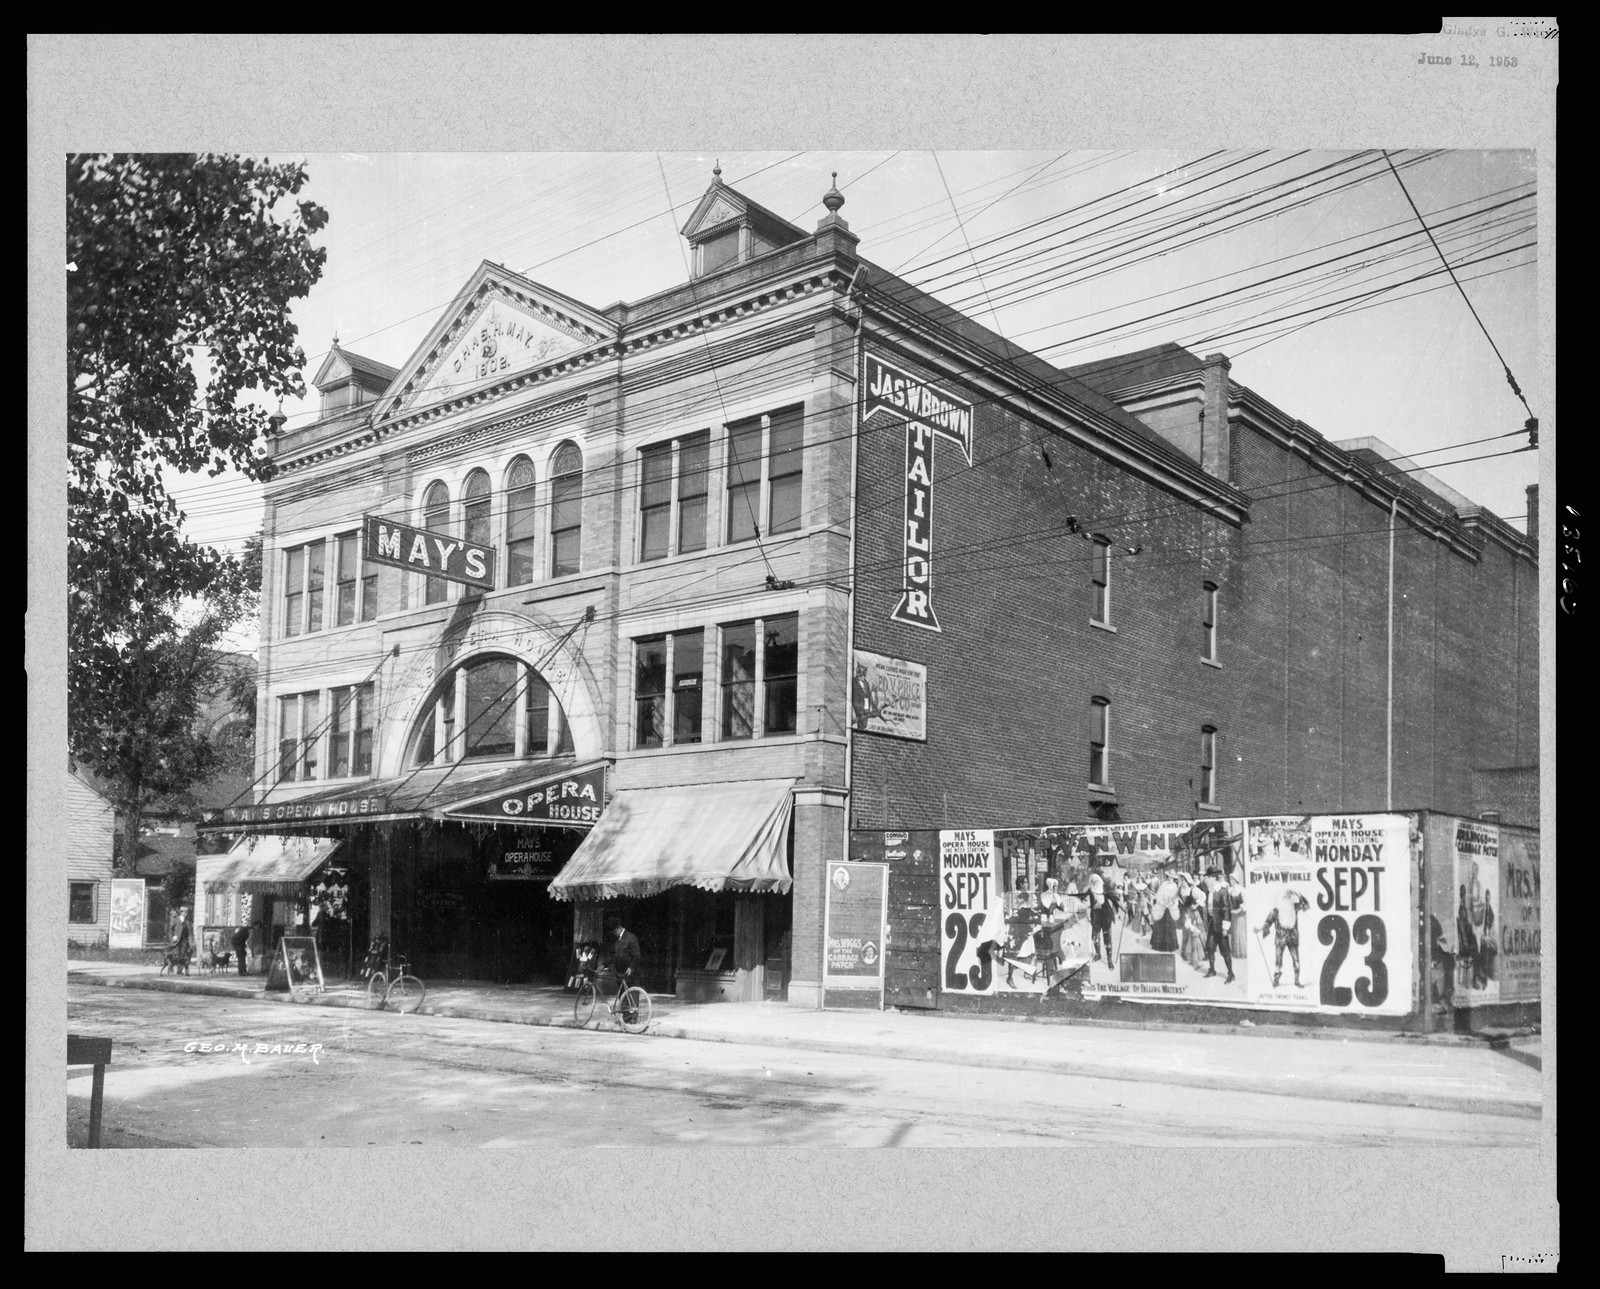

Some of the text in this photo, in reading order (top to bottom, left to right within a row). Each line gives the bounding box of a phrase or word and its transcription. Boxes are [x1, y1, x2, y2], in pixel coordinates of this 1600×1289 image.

[907, 421, 931, 618] TAILOR
[378, 525, 486, 579] MAY'S
[502, 780, 597, 815] OPERA
[276, 803, 321, 819] OPERA
[549, 804, 601, 821] HOUSE
[1332, 818, 1363, 830] MAYS
[886, 832, 908, 840] COMING
[954, 831, 975, 841] MAYS
[1315, 829, 1384, 838] OPERA HOUSE
[967, 840, 990, 848] HOUSE
[1002, 836, 1051, 858] RIP
[1057, 834, 1109, 858] VAN
[504, 851, 552, 863] OPERA HOUSE
[943, 853, 990, 869] MONDAY
[1315, 844, 1383, 862] MONDAY
[1250, 871, 1311, 884] RIP VAN WINKLE
[944, 871, 992, 911] SEPT
[1317, 867, 1385, 911] SEPT
[828, 954, 859, 962] CABBAGE
[945, 912, 993, 991] 23
[1317, 914, 1389, 1007] 23
[1107, 983, 1130, 993] VILLAGE
